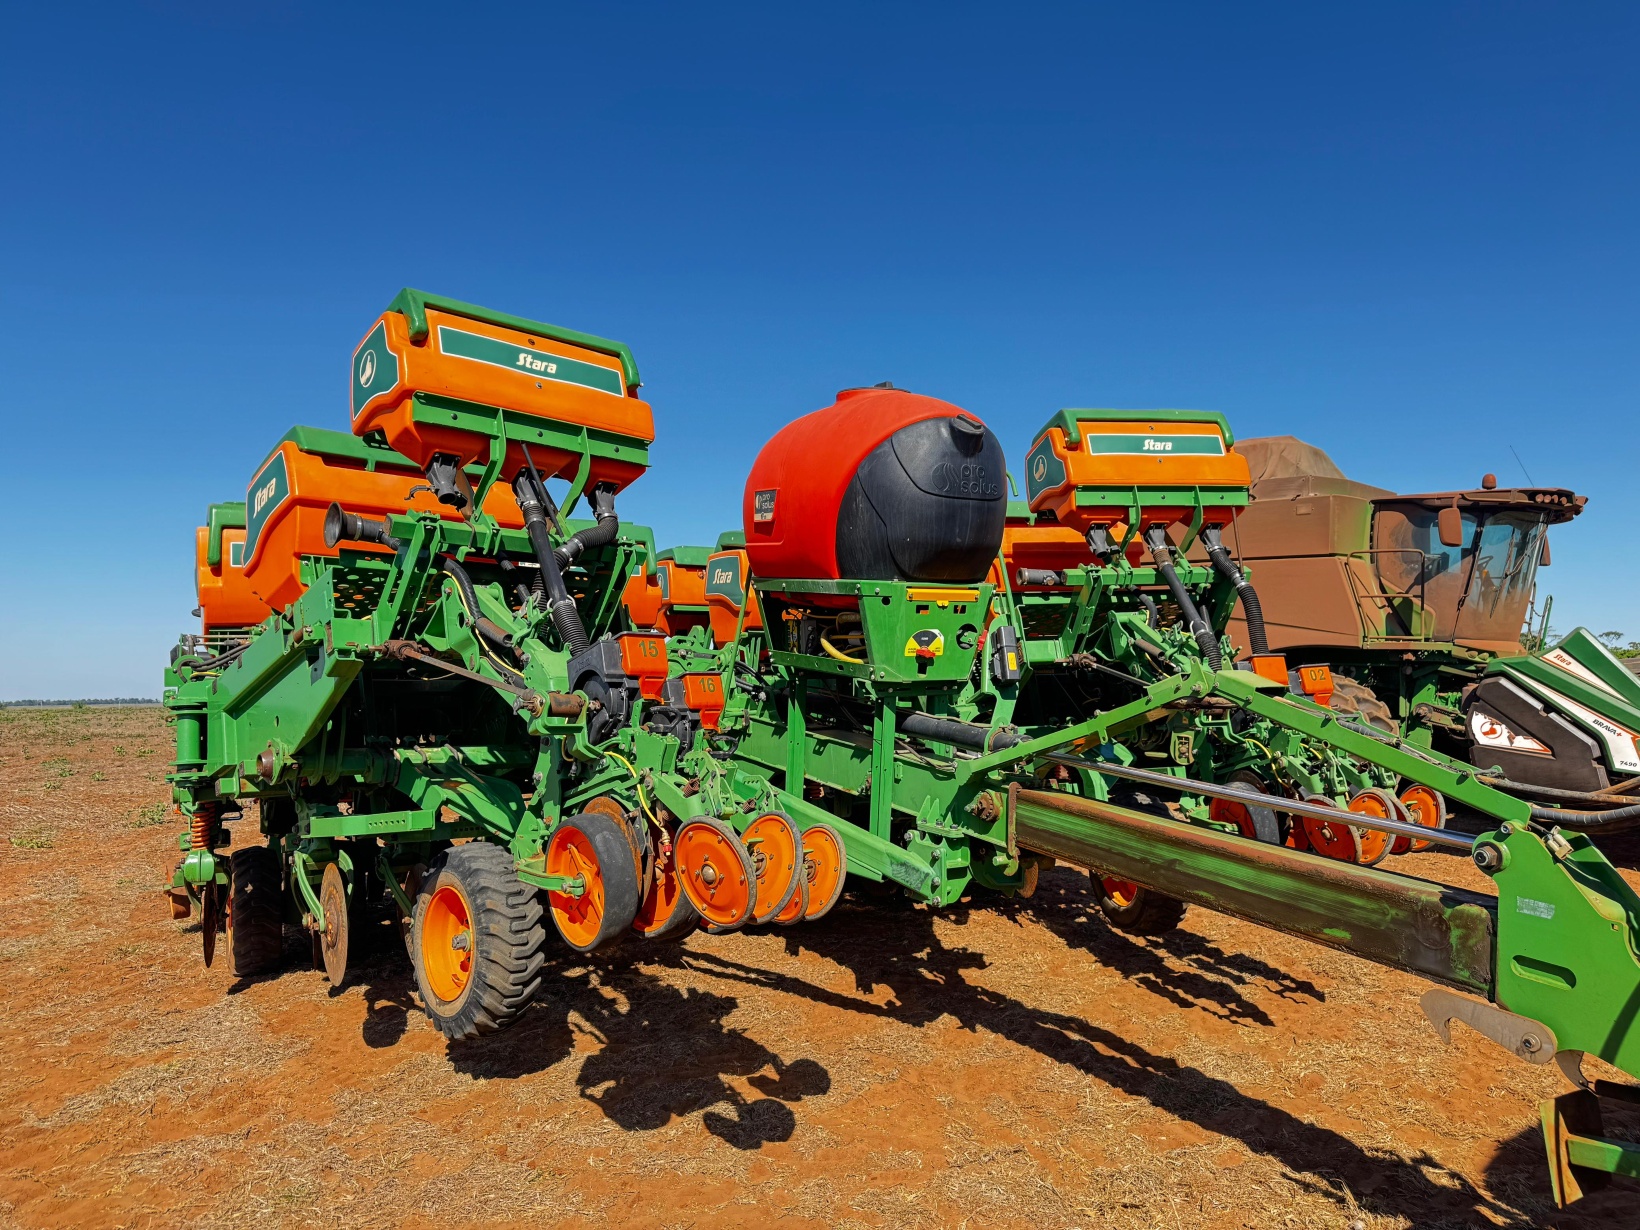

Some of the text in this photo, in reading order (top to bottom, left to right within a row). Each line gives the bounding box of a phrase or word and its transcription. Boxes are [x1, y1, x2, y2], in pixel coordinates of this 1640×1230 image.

[516, 353, 557, 374] Stara
[1142, 438, 1173, 451] Stara
[961, 464, 985, 481] pro
[961, 479, 998, 496] solus
[253, 477, 276, 519] Stara
[712, 568, 733, 585] Stara
[638, 640, 659, 657] 15
[1553, 653, 1572, 666] Stara
[1310, 669, 1326, 681] 02
[699, 677, 716, 693] 16
[1620, 760, 1638, 768] 7490
